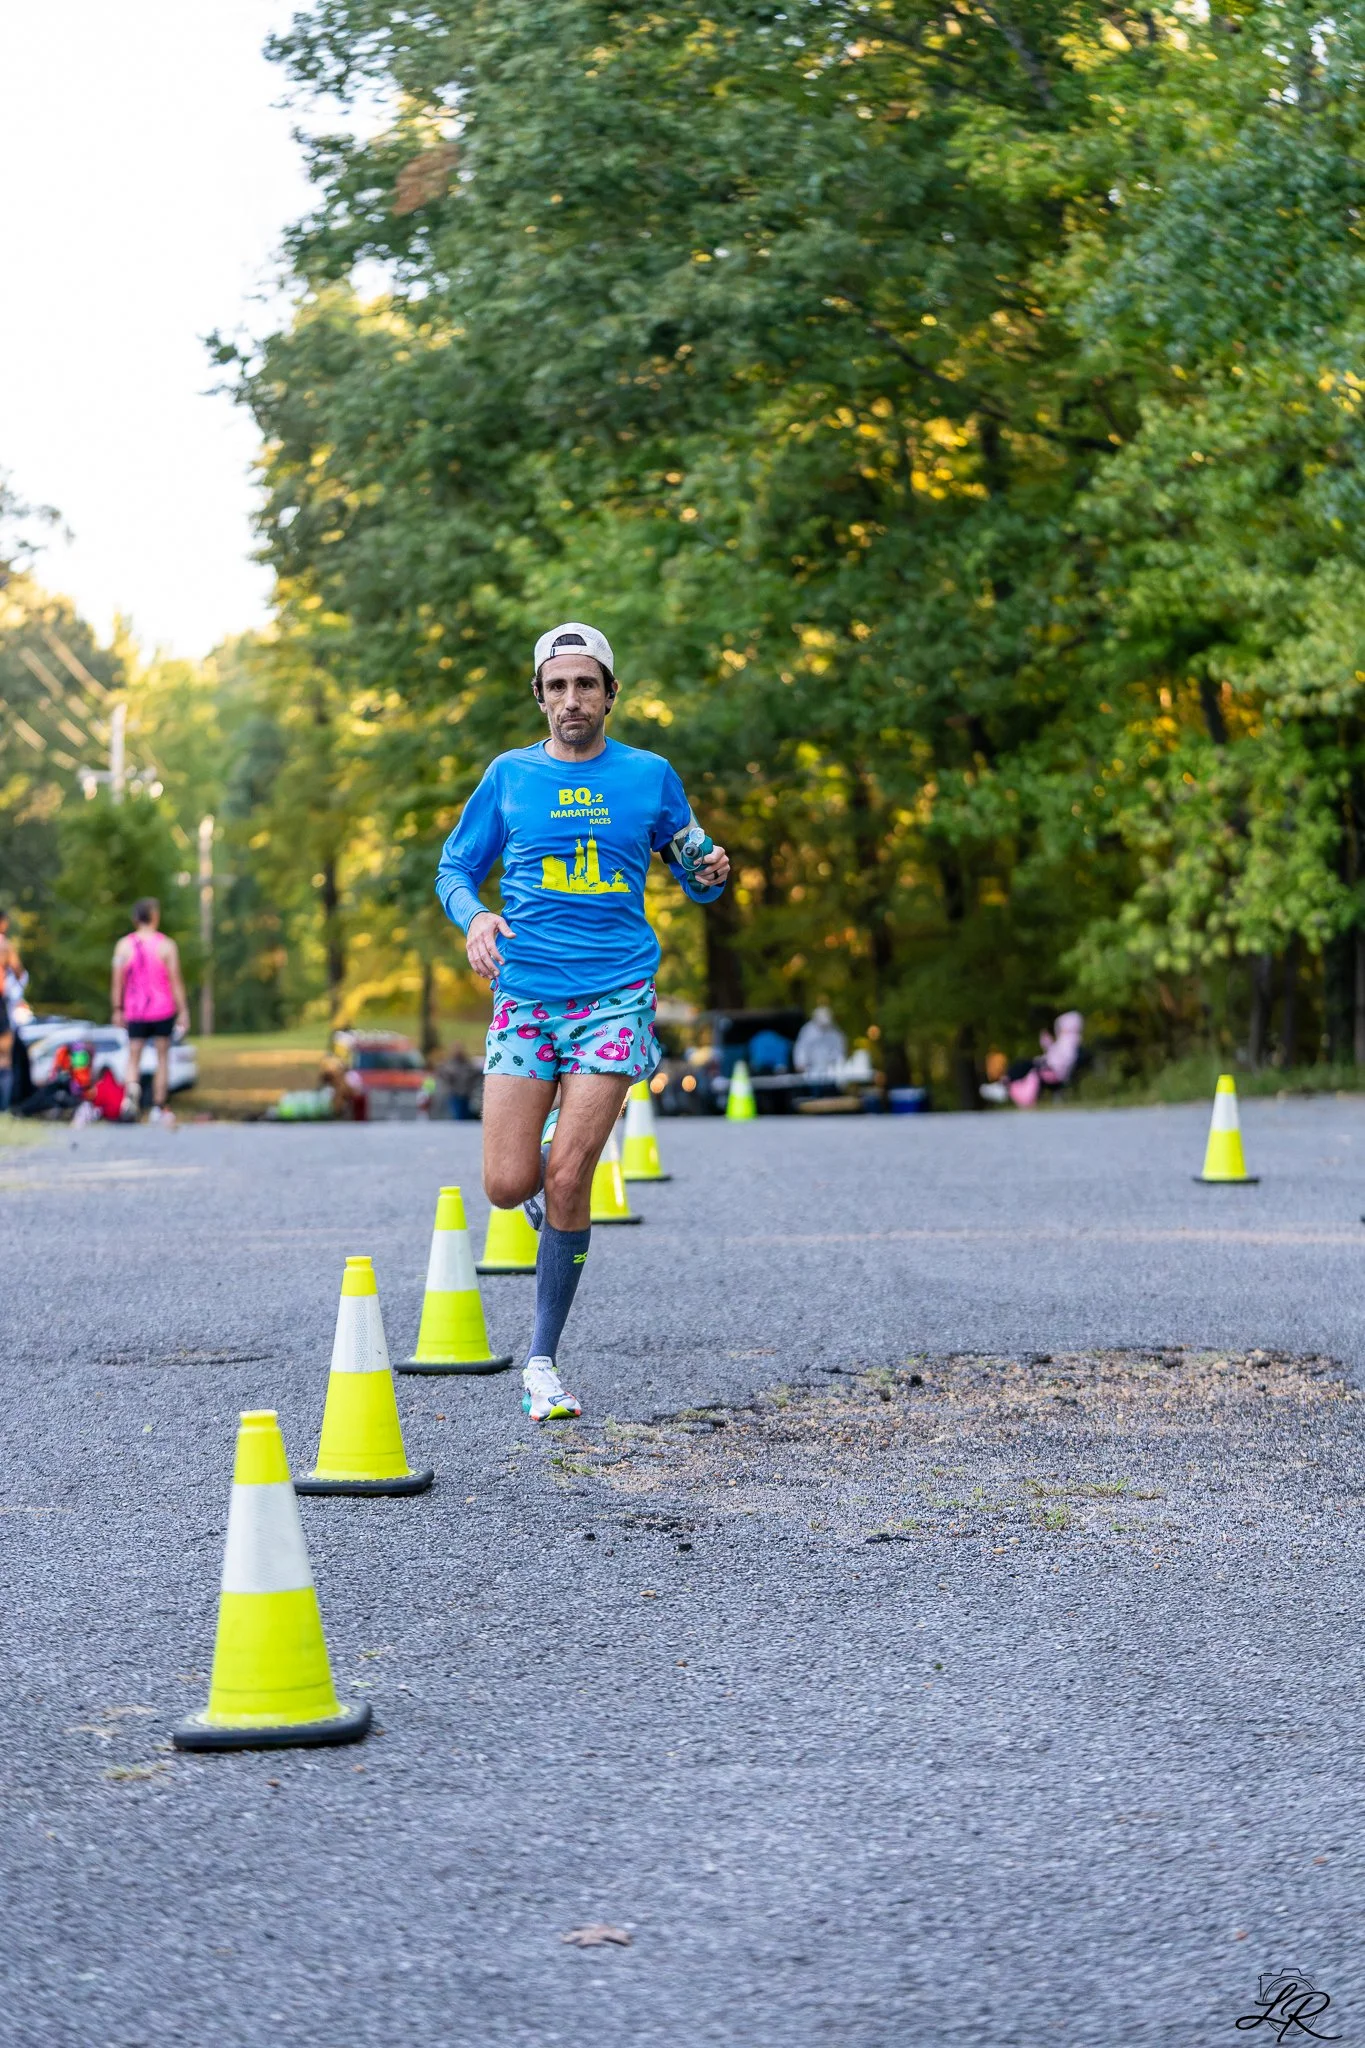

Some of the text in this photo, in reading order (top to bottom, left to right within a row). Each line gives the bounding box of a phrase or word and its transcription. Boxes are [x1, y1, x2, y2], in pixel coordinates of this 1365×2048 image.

[558, 787, 604, 806] BQ.2
[550, 808, 609, 818] MARATHON
[589, 817, 612, 825] RACES
